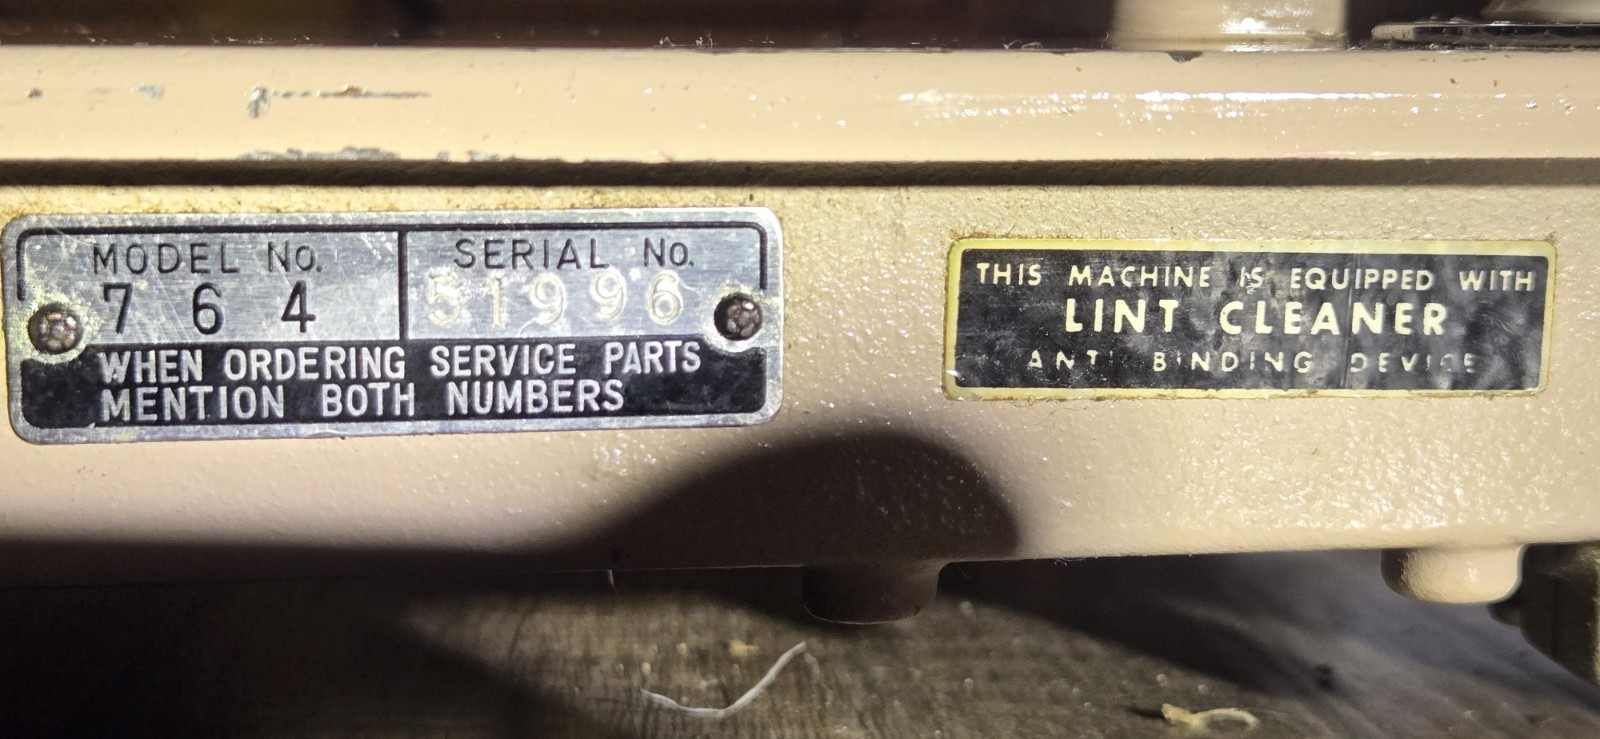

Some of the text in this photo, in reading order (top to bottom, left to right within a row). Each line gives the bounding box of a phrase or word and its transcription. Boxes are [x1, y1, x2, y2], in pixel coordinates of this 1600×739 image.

[93, 239, 324, 275] MODEL No.
[453, 237, 695, 270] SERIAL No.
[976, 262, 1536, 292] THIS MACHINE IS EQUIPPED WITH
[427, 267, 685, 327] 51996
[1065, 298, 1448, 336] LINT CLEANER
[100, 340, 702, 385] WHEN ORDERING SERVICE PARTS
[101, 379, 625, 422] MENTION BOTH NUMBERS
